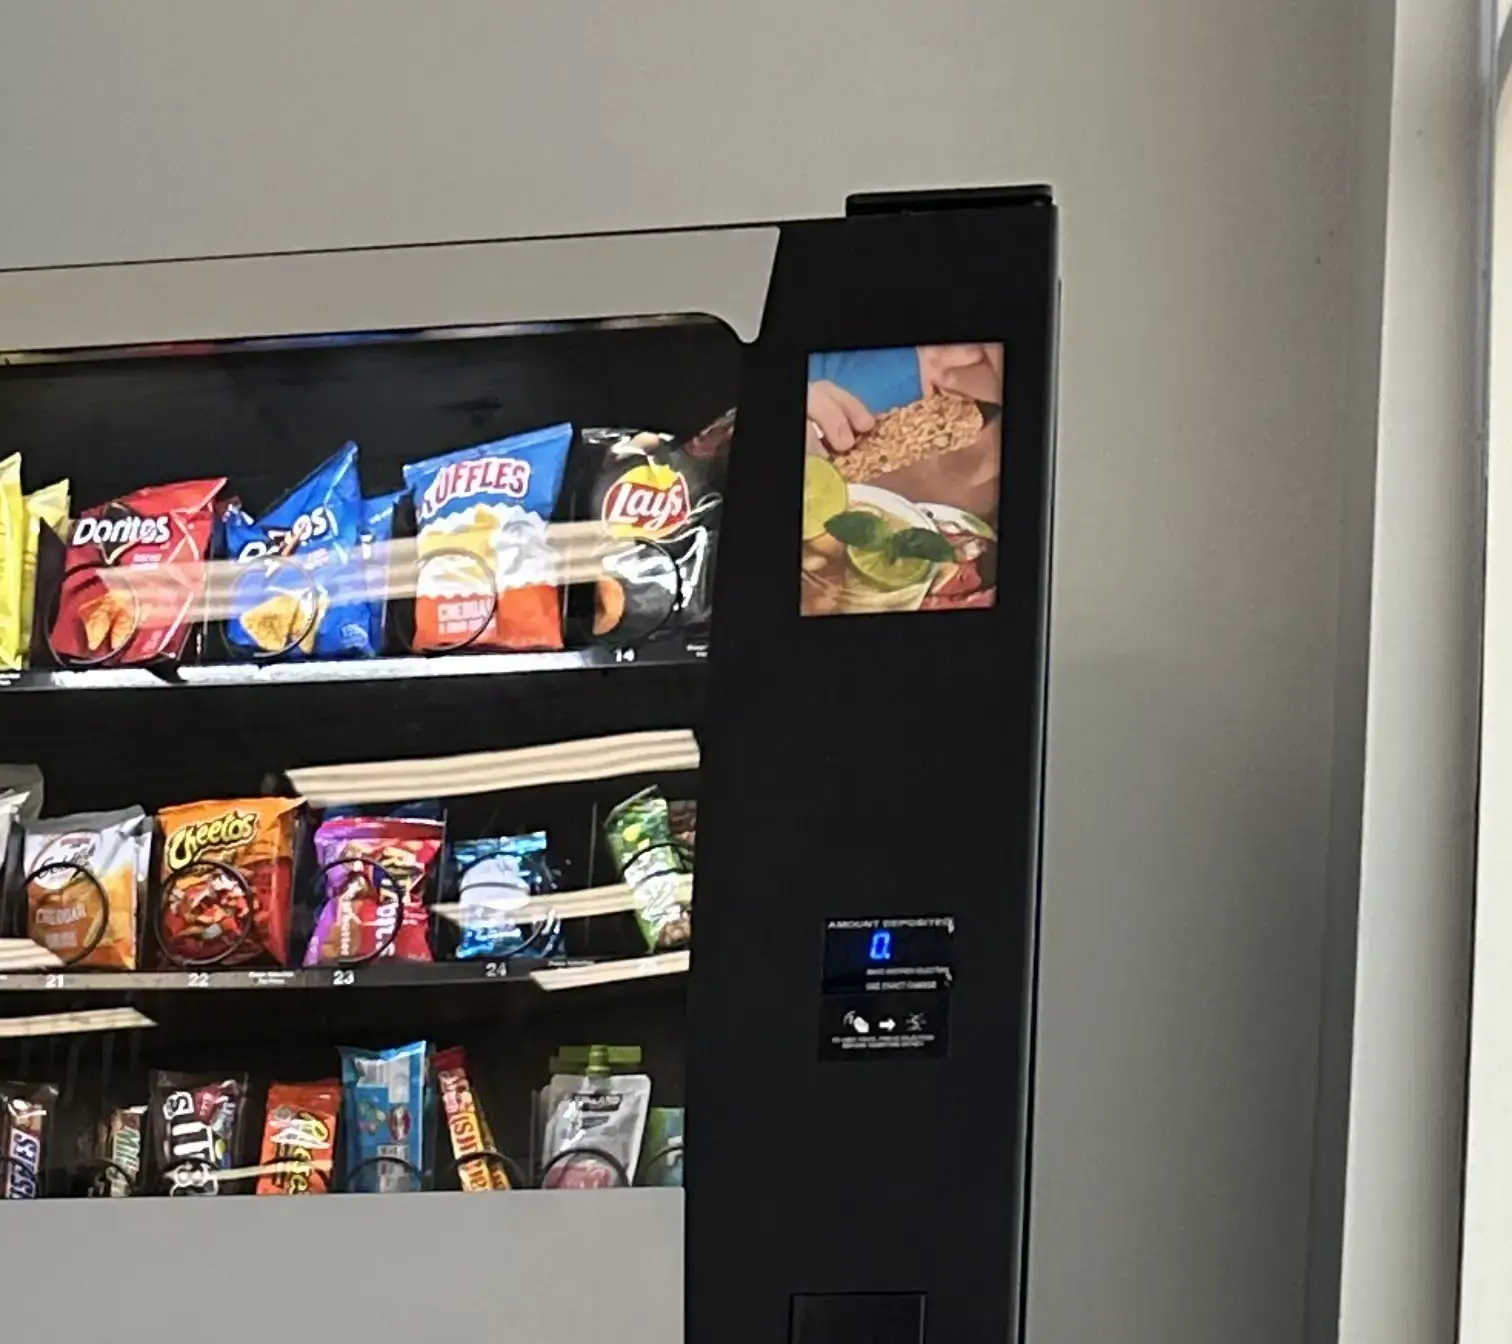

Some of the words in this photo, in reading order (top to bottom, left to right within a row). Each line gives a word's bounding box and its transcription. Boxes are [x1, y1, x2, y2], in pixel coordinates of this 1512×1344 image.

[72, 516, 171, 546] Doritos
[614, 648, 635, 662] 14
[168, 811, 257, 870] Cheetos
[333, 970, 355, 984] 23
[485, 962, 507, 977] 24
[45, 974, 64, 988] 21
[188, 972, 209, 987] 22
